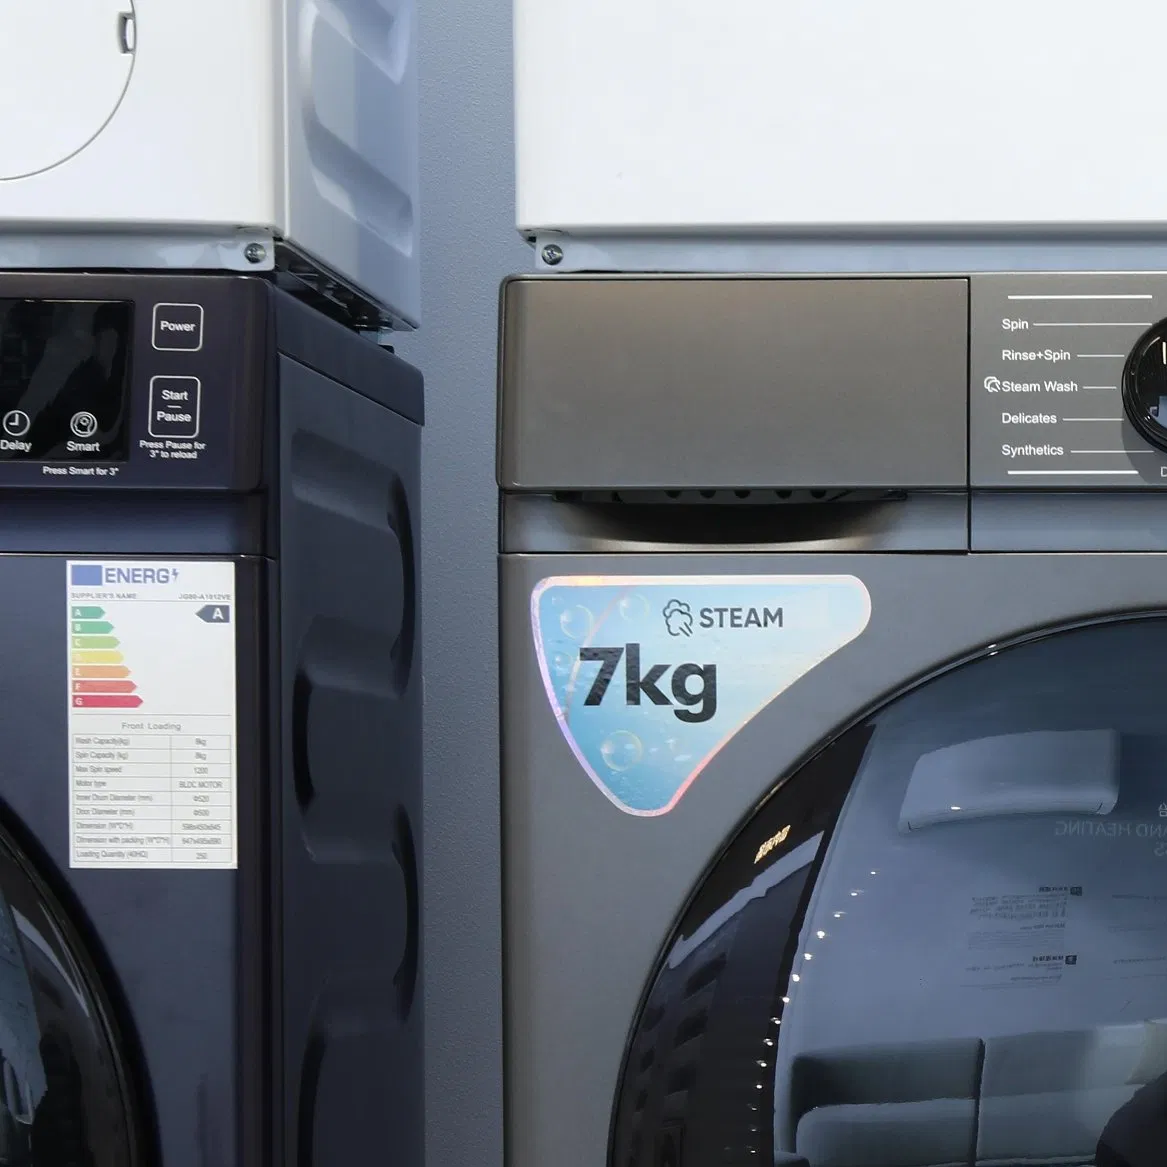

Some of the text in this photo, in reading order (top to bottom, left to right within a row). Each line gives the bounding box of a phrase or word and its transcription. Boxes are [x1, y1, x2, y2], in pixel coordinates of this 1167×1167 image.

[161, 321, 195, 331] Power
[1002, 319, 1028, 330] Spin
[1002, 350, 1071, 363] Rinse+Spin
[1002, 381, 1078, 392] Steam Wash
[162, 390, 188, 400] Start
[157, 412, 191, 422] Pause
[1002, 413, 1056, 424] Delicates
[1, 440, 32, 452] Delay
[67, 442, 99, 452] Smart
[140, 441, 164, 449] Press
[166, 441, 192, 449] Pause
[1002, 444, 1064, 457] Synthetics
[150, 450, 159, 458] 3"
[171, 451, 197, 459] reload
[69, 467, 94, 475] Smart
[96, 467, 108, 475] for
[110, 468, 119, 476] 3"
[105, 568, 169, 583] ENERG
[212, 608, 224, 619] A
[700, 608, 783, 628] STEAM
[579, 643, 717, 723] 7kg
